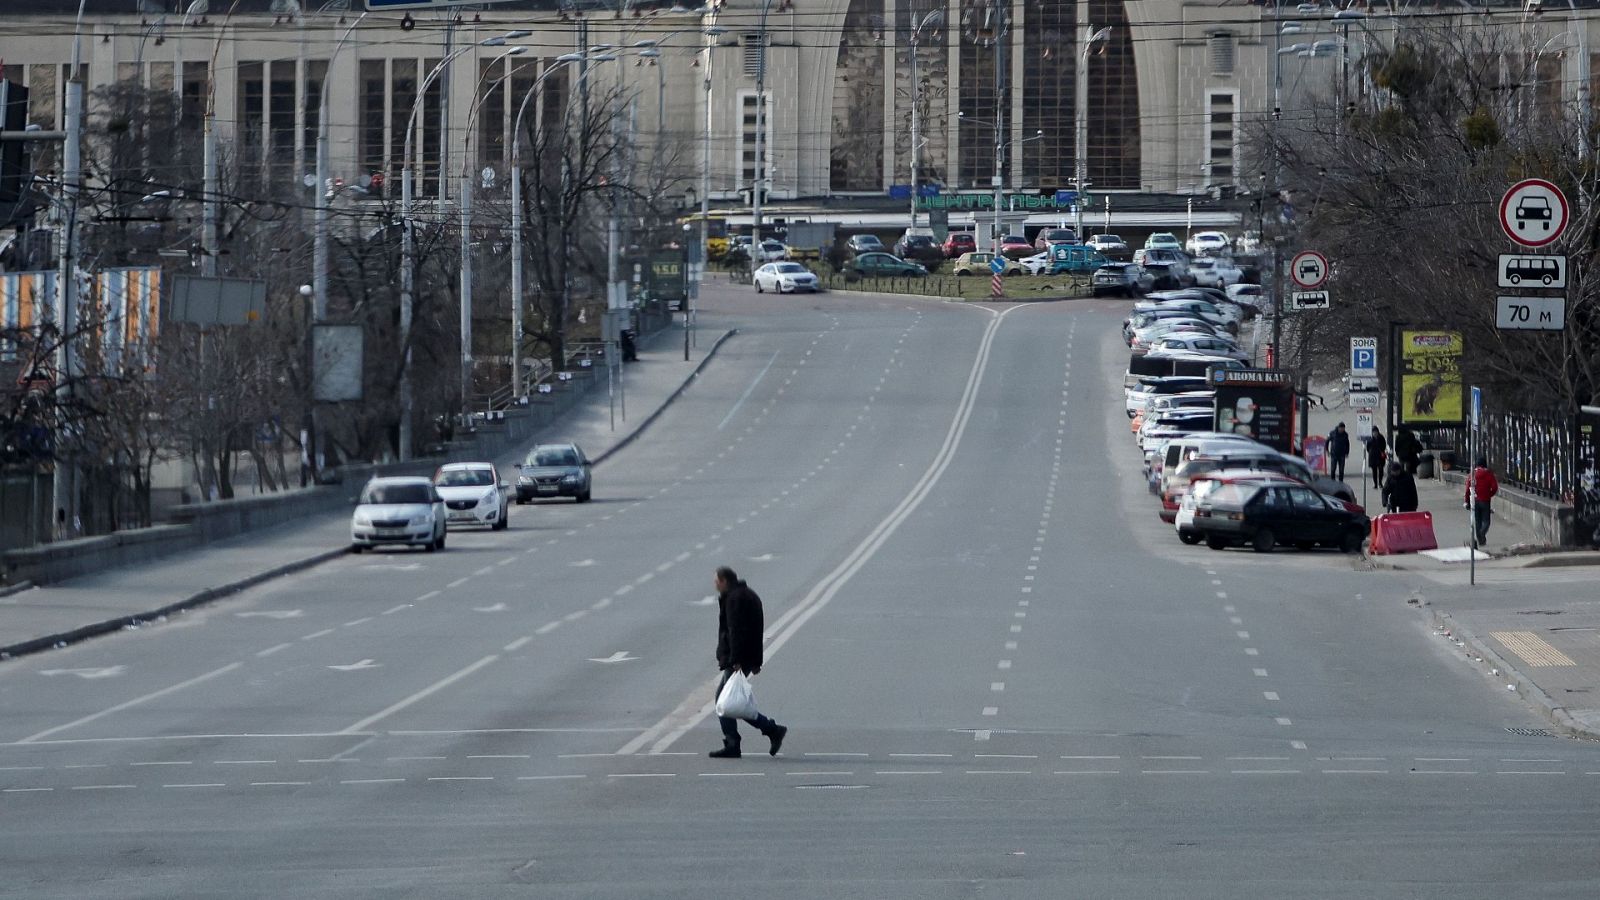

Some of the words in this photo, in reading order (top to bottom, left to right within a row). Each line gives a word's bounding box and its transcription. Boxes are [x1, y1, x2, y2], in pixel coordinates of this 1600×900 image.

[1508, 305, 1530, 322] 70
[1359, 350, 1370, 367] P
[1227, 372, 1263, 382] AROMA
